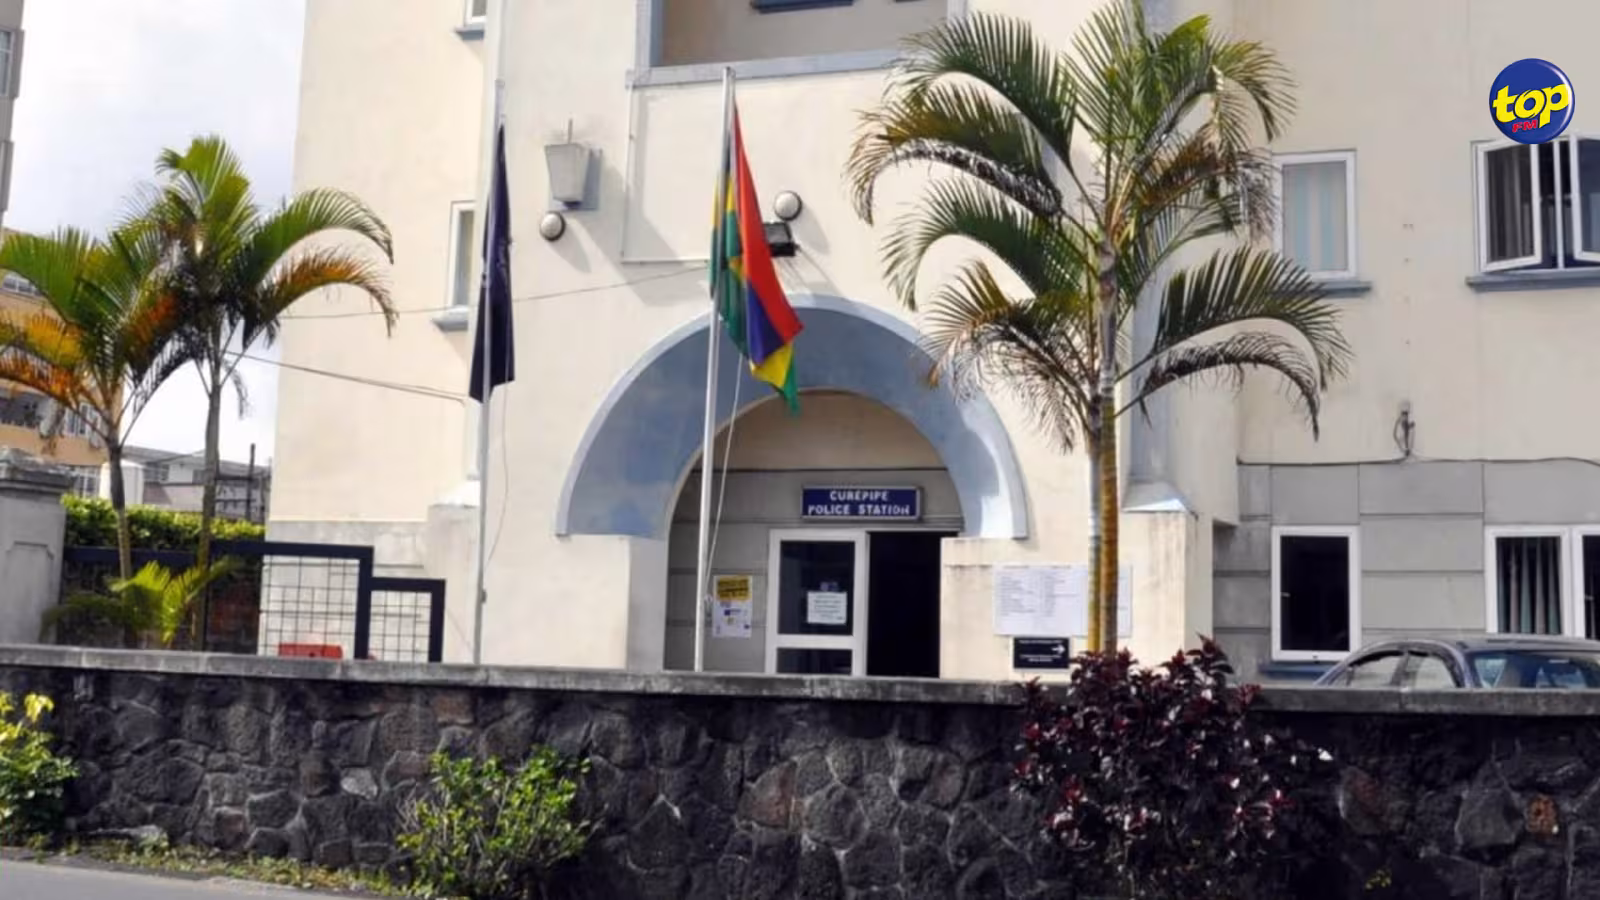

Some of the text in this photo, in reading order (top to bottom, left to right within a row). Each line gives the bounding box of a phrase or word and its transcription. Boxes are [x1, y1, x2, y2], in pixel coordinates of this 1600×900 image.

[829, 490, 889, 501] CUREPIPE
[808, 504, 910, 515] POLICE STATION
